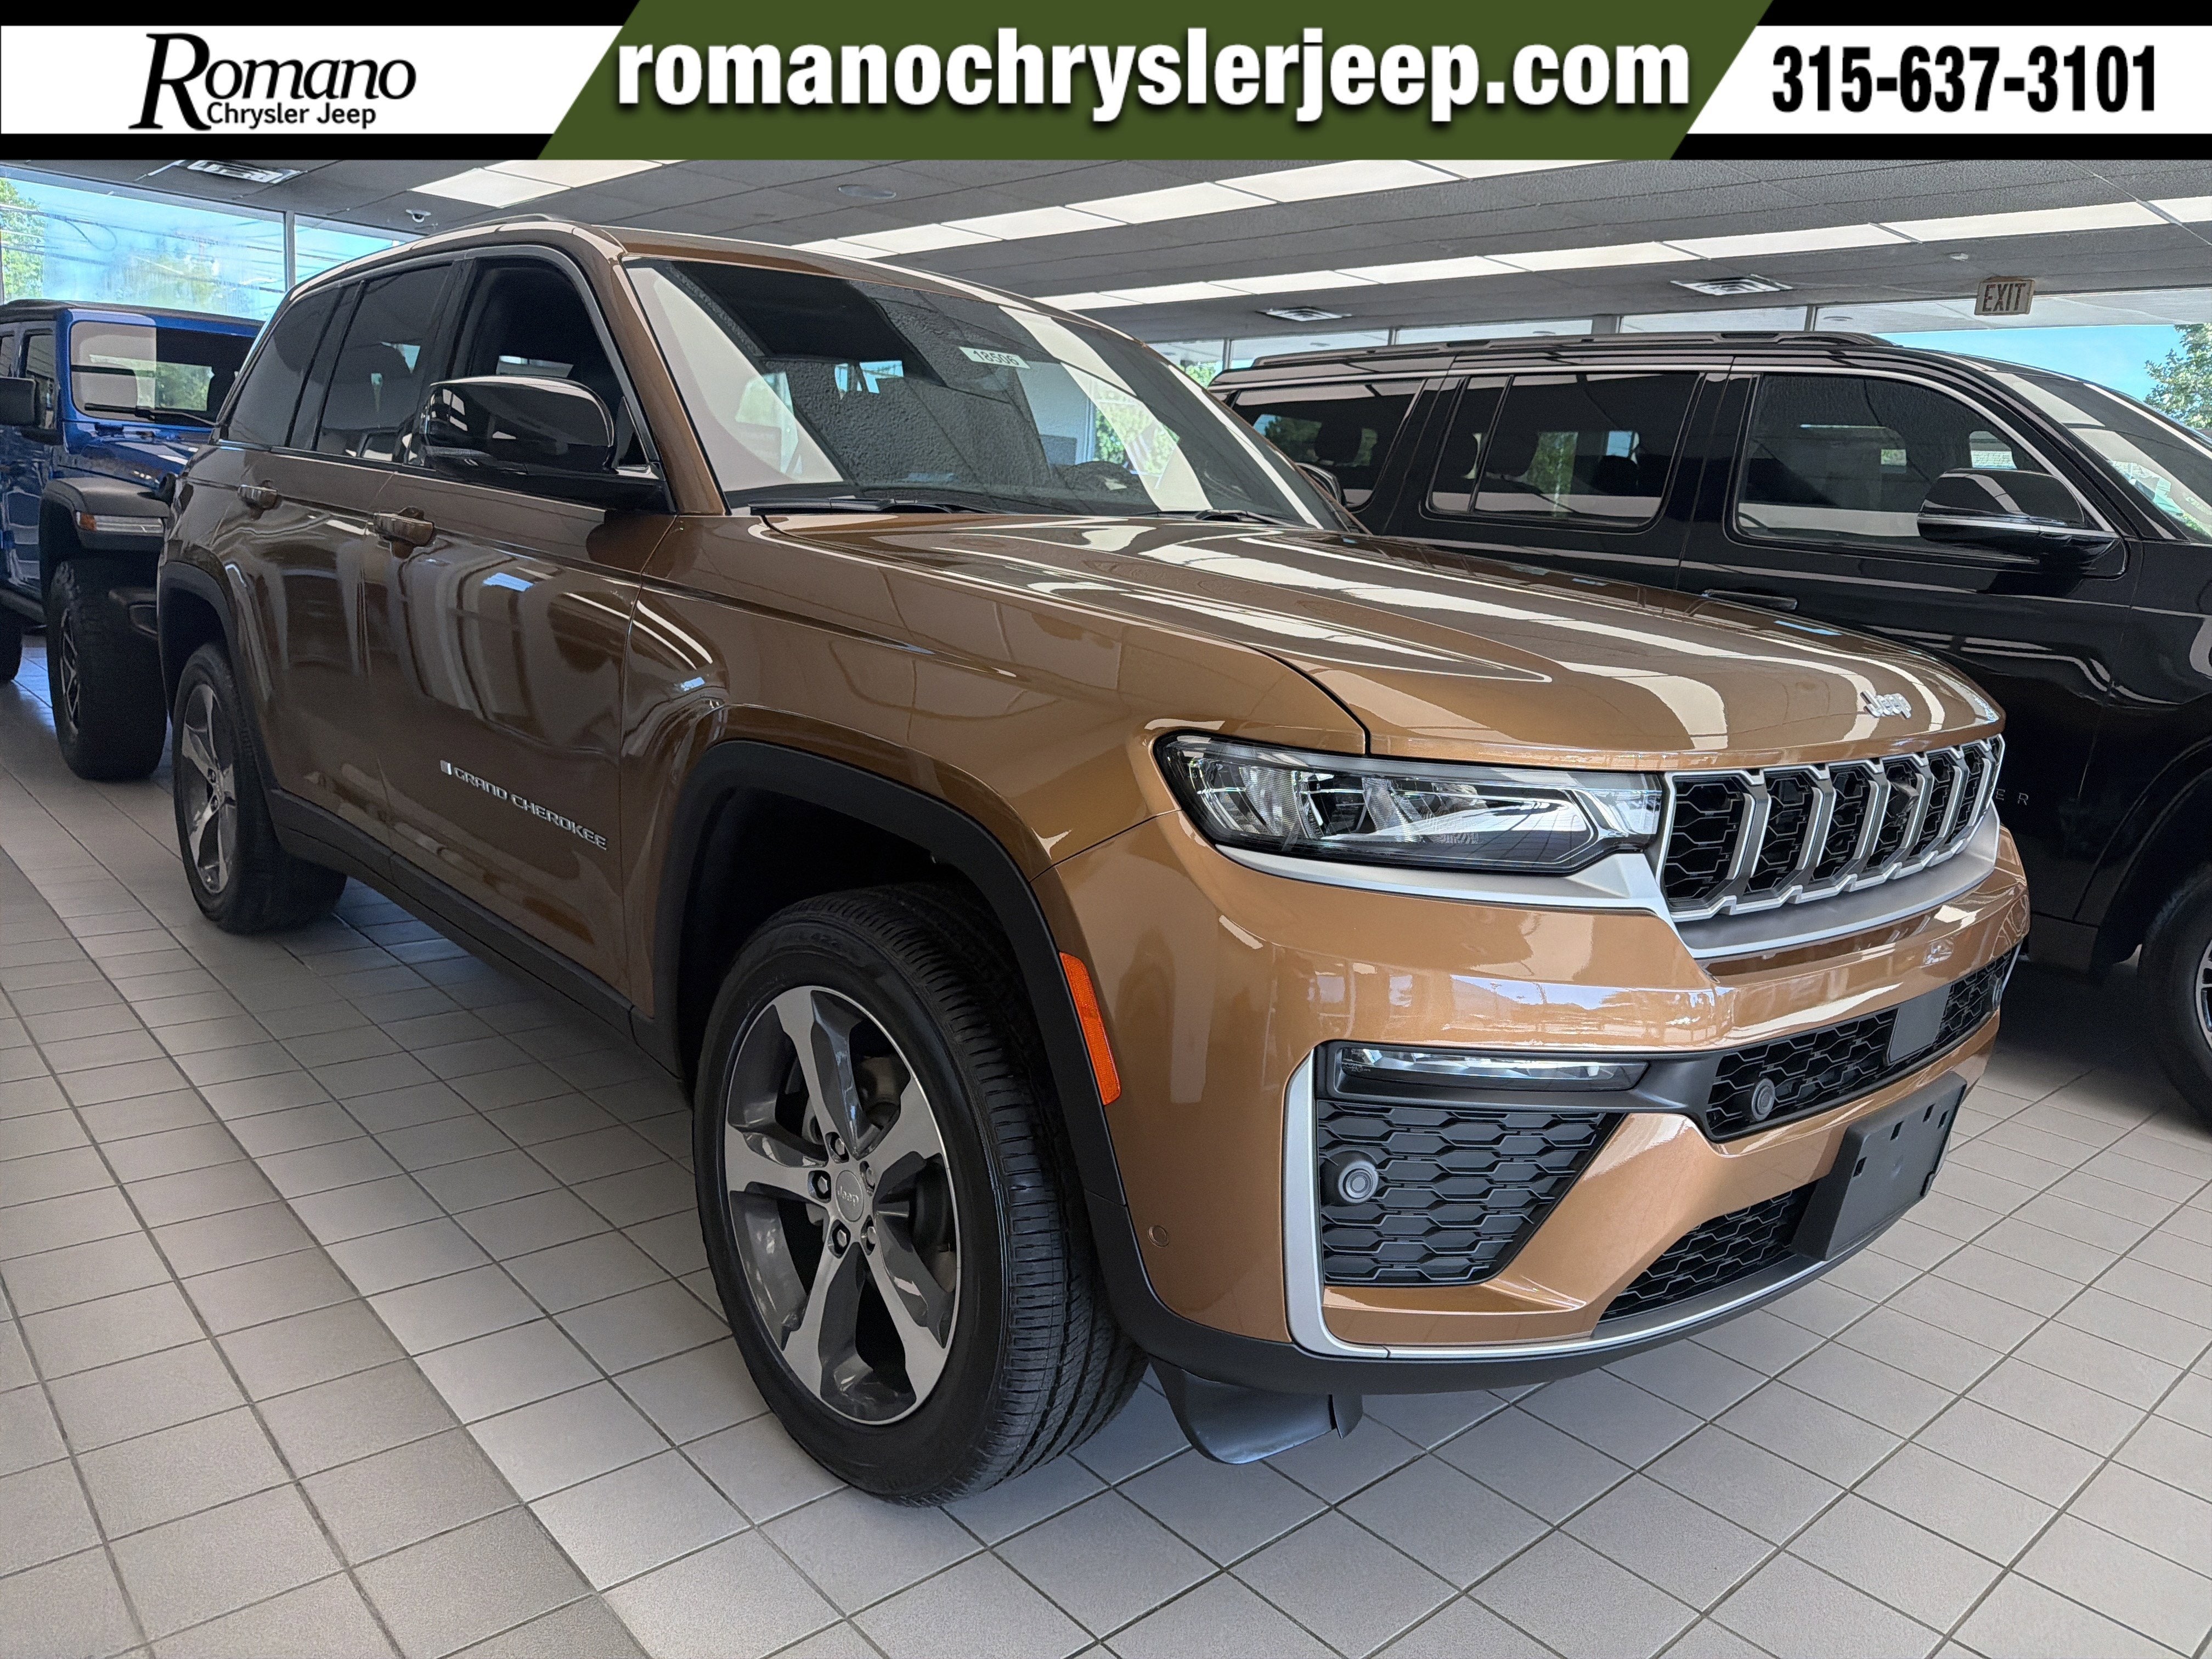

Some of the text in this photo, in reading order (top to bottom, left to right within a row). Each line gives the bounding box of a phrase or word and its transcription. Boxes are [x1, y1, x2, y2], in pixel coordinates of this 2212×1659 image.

[1982, 283, 2026, 312] EXIT
[973, 350, 1019, 366] 18506
[1860, 690, 1911, 719] Jeep
[454, 768, 607, 851] GRAND CHEROKEE
